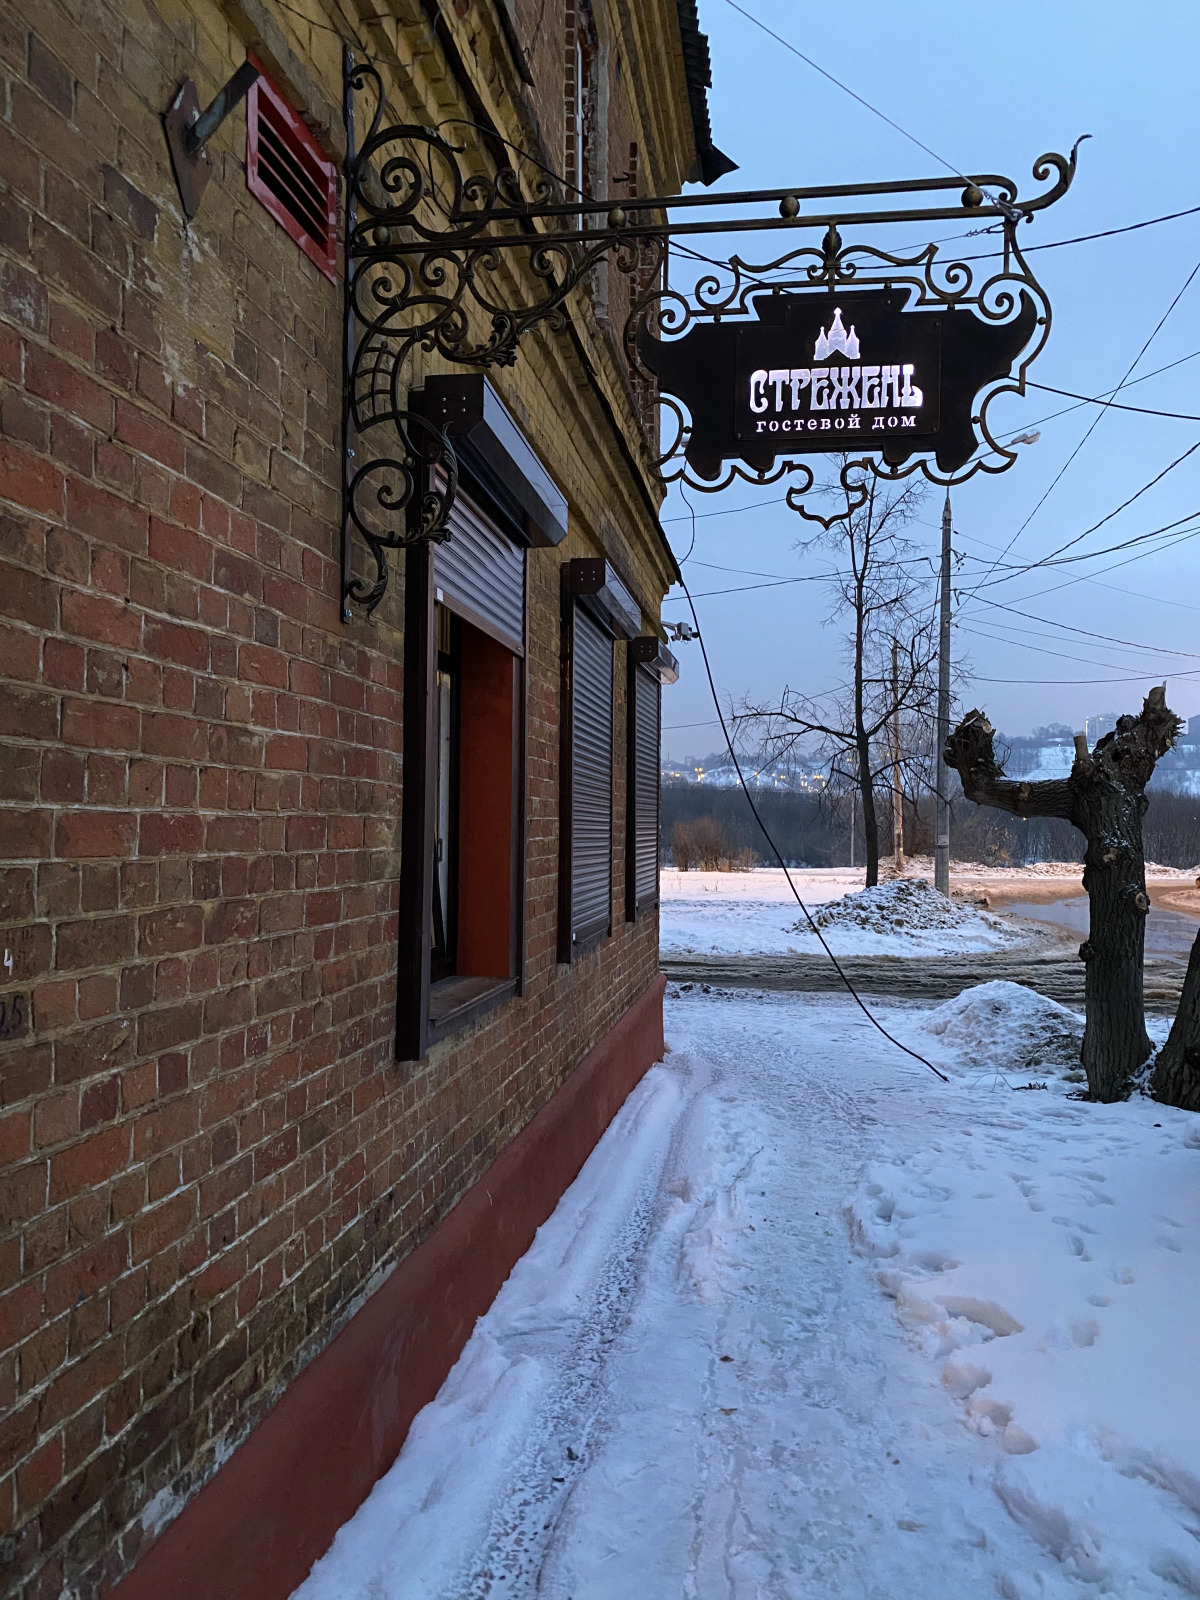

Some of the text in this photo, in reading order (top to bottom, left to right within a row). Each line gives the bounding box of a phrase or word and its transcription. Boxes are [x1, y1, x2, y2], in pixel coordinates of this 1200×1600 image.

[749, 363, 924, 413] СТРЕЖЕНЬ
[755, 413, 917, 433] гостевой дом
